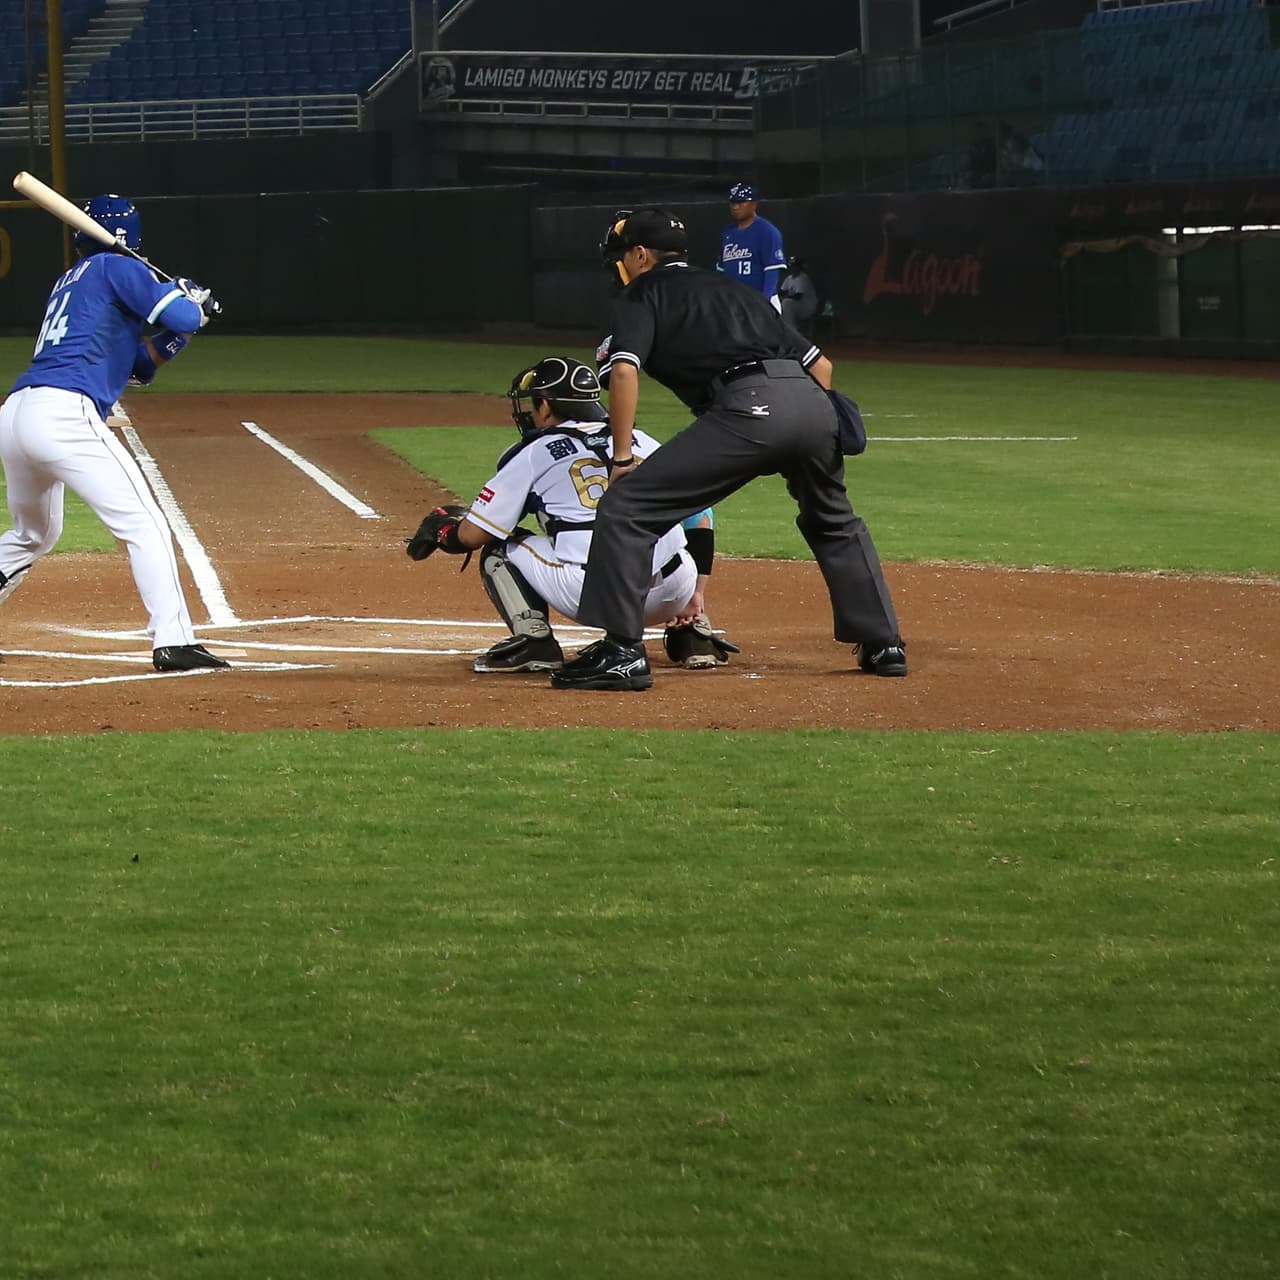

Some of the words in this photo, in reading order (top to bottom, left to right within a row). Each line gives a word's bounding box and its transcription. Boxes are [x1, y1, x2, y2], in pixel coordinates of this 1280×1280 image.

[463, 67, 525, 89] LAMIGO
[528, 68, 607, 90] MONKEYS
[611, 70, 650, 90] 2017
[653, 71, 684, 92] GET
[689, 72, 733, 93] REAL
[722, 243, 753, 262] Fubon
[738, 261, 752, 275] 13
